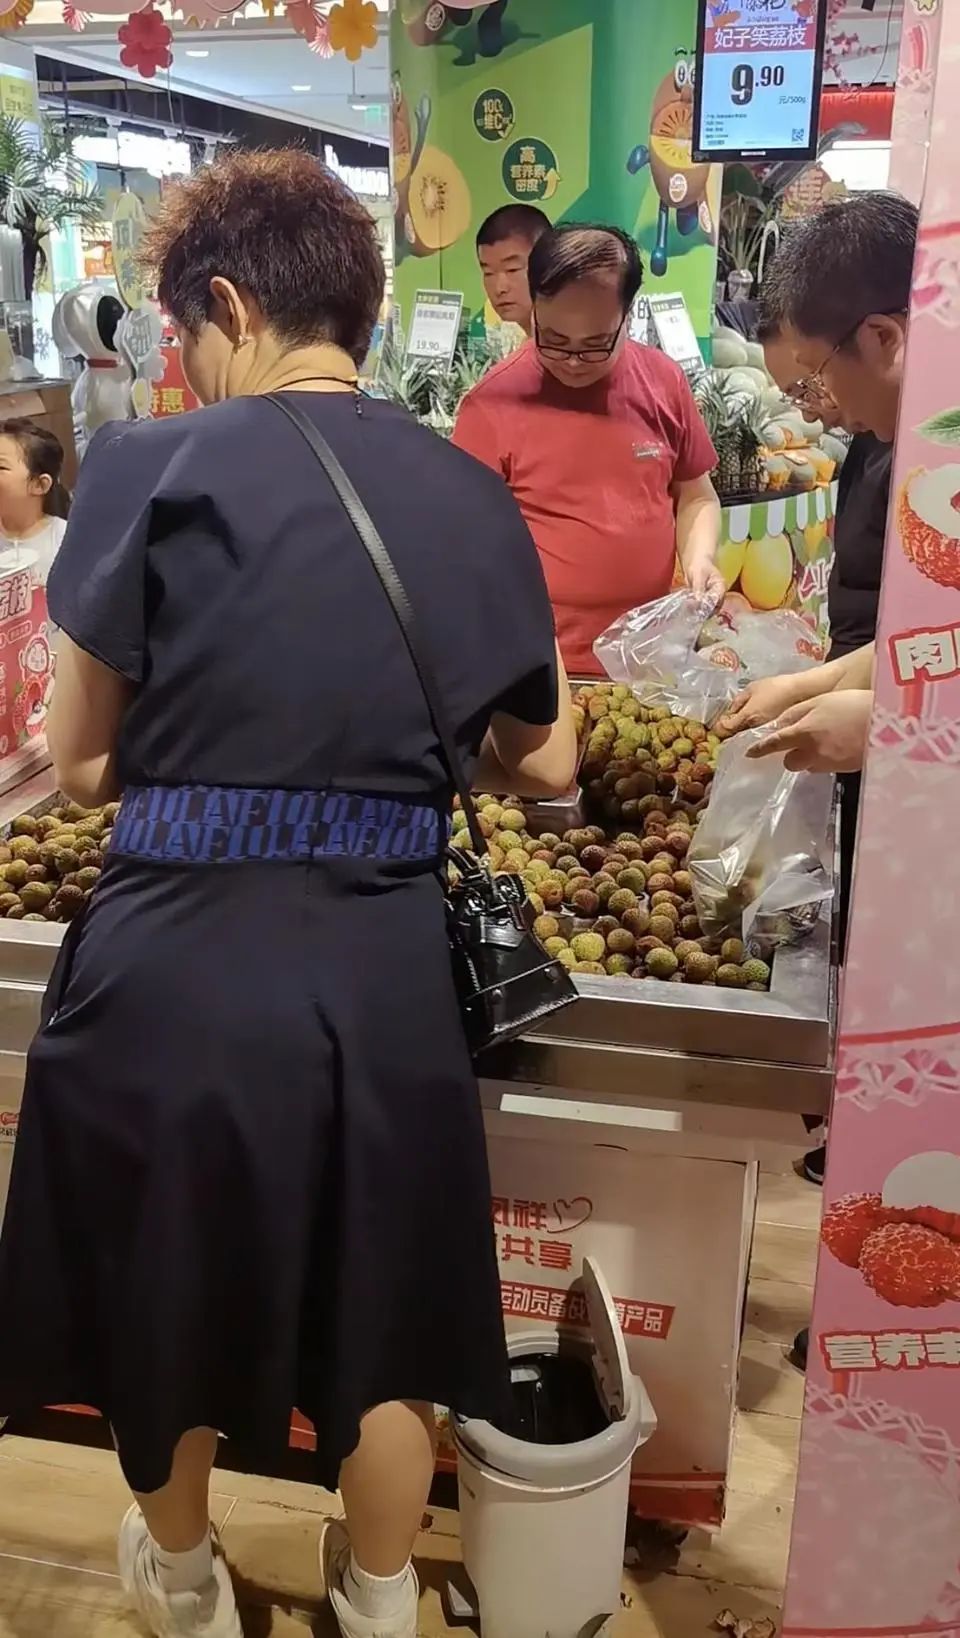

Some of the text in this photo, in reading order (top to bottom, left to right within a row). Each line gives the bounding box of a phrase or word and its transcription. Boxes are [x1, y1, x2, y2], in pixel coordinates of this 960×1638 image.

[714, 26, 807, 48] 妃子笑荔枝
[731, 64, 784, 105] 9.90
[779, 96, 806, 104] 元/500g
[520, 146, 536, 163] 高
[516, 178, 539, 192] 密度
[416, 339, 440, 351] 19.90
[894, 627, 960, 681] 肉
[496, 1232, 573, 1271] 共享
